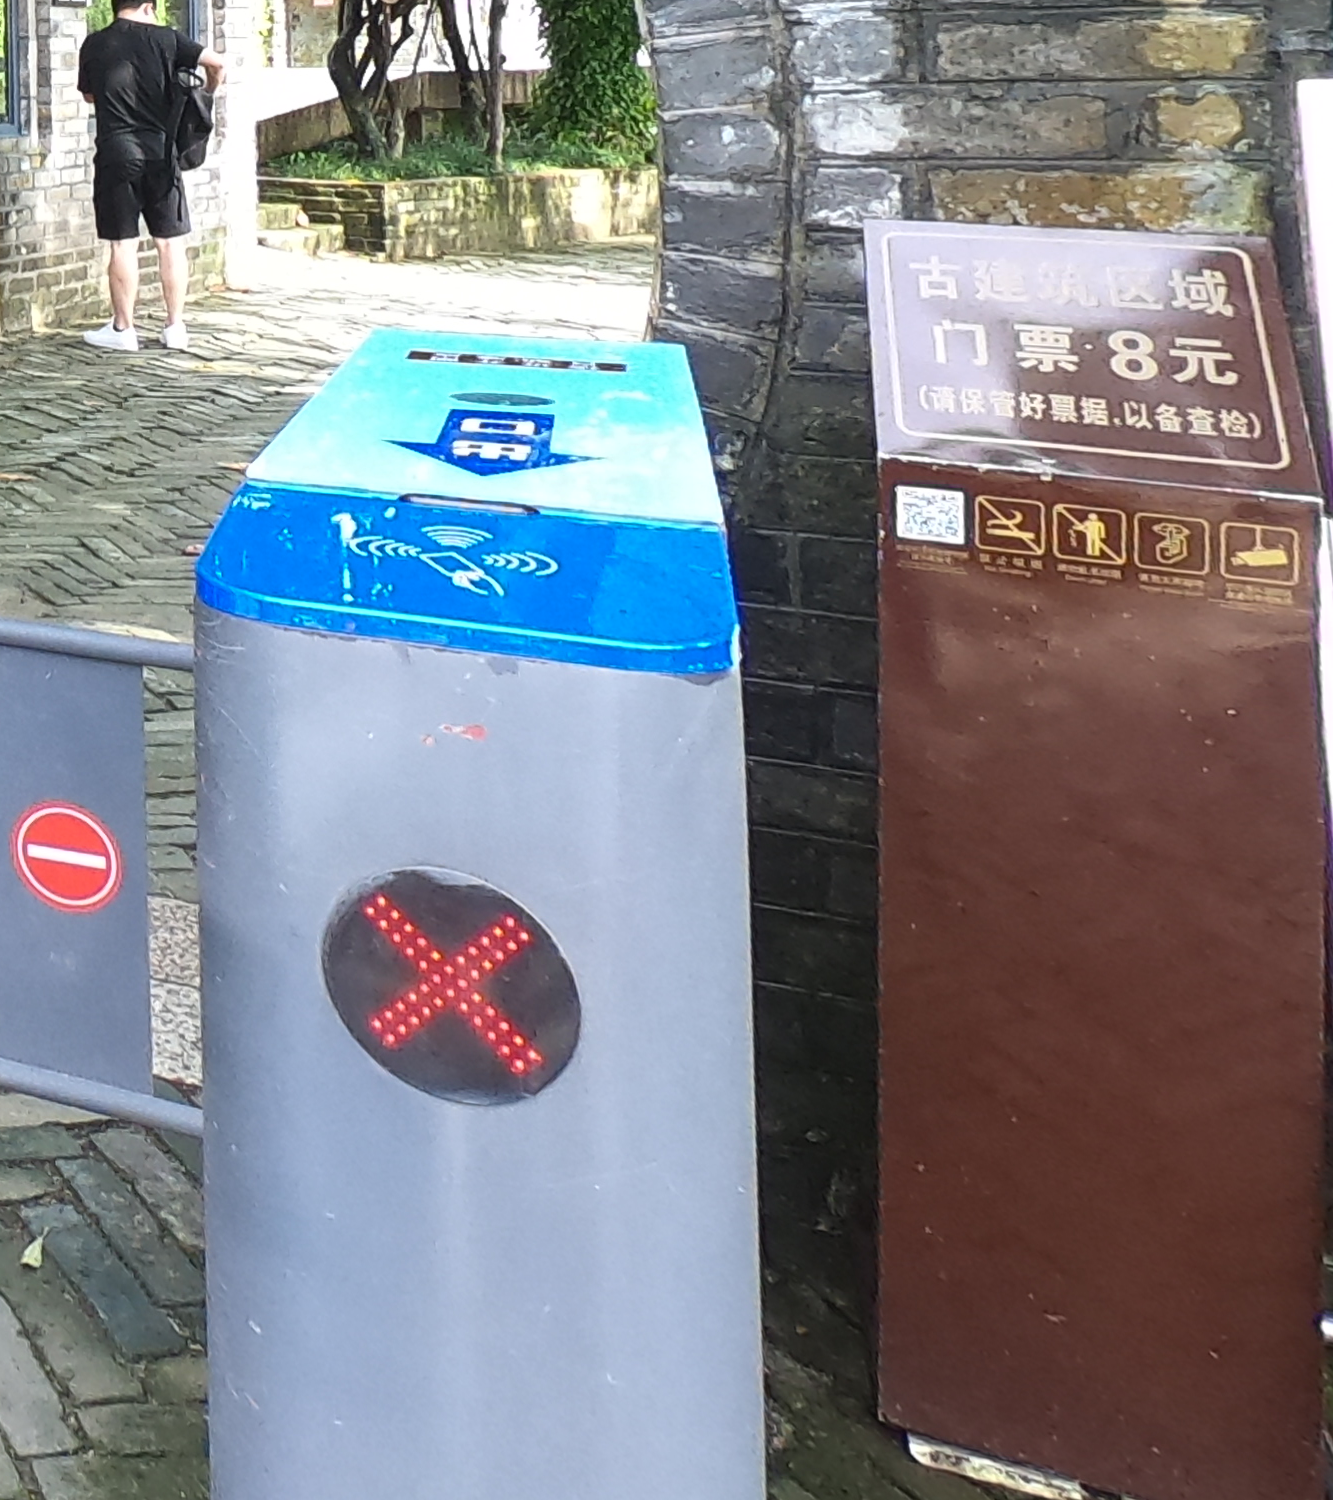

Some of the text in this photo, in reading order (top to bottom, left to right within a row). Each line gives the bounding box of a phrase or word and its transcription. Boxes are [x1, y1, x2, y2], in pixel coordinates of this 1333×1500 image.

[909, 255, 1234, 318] 古建筑区域
